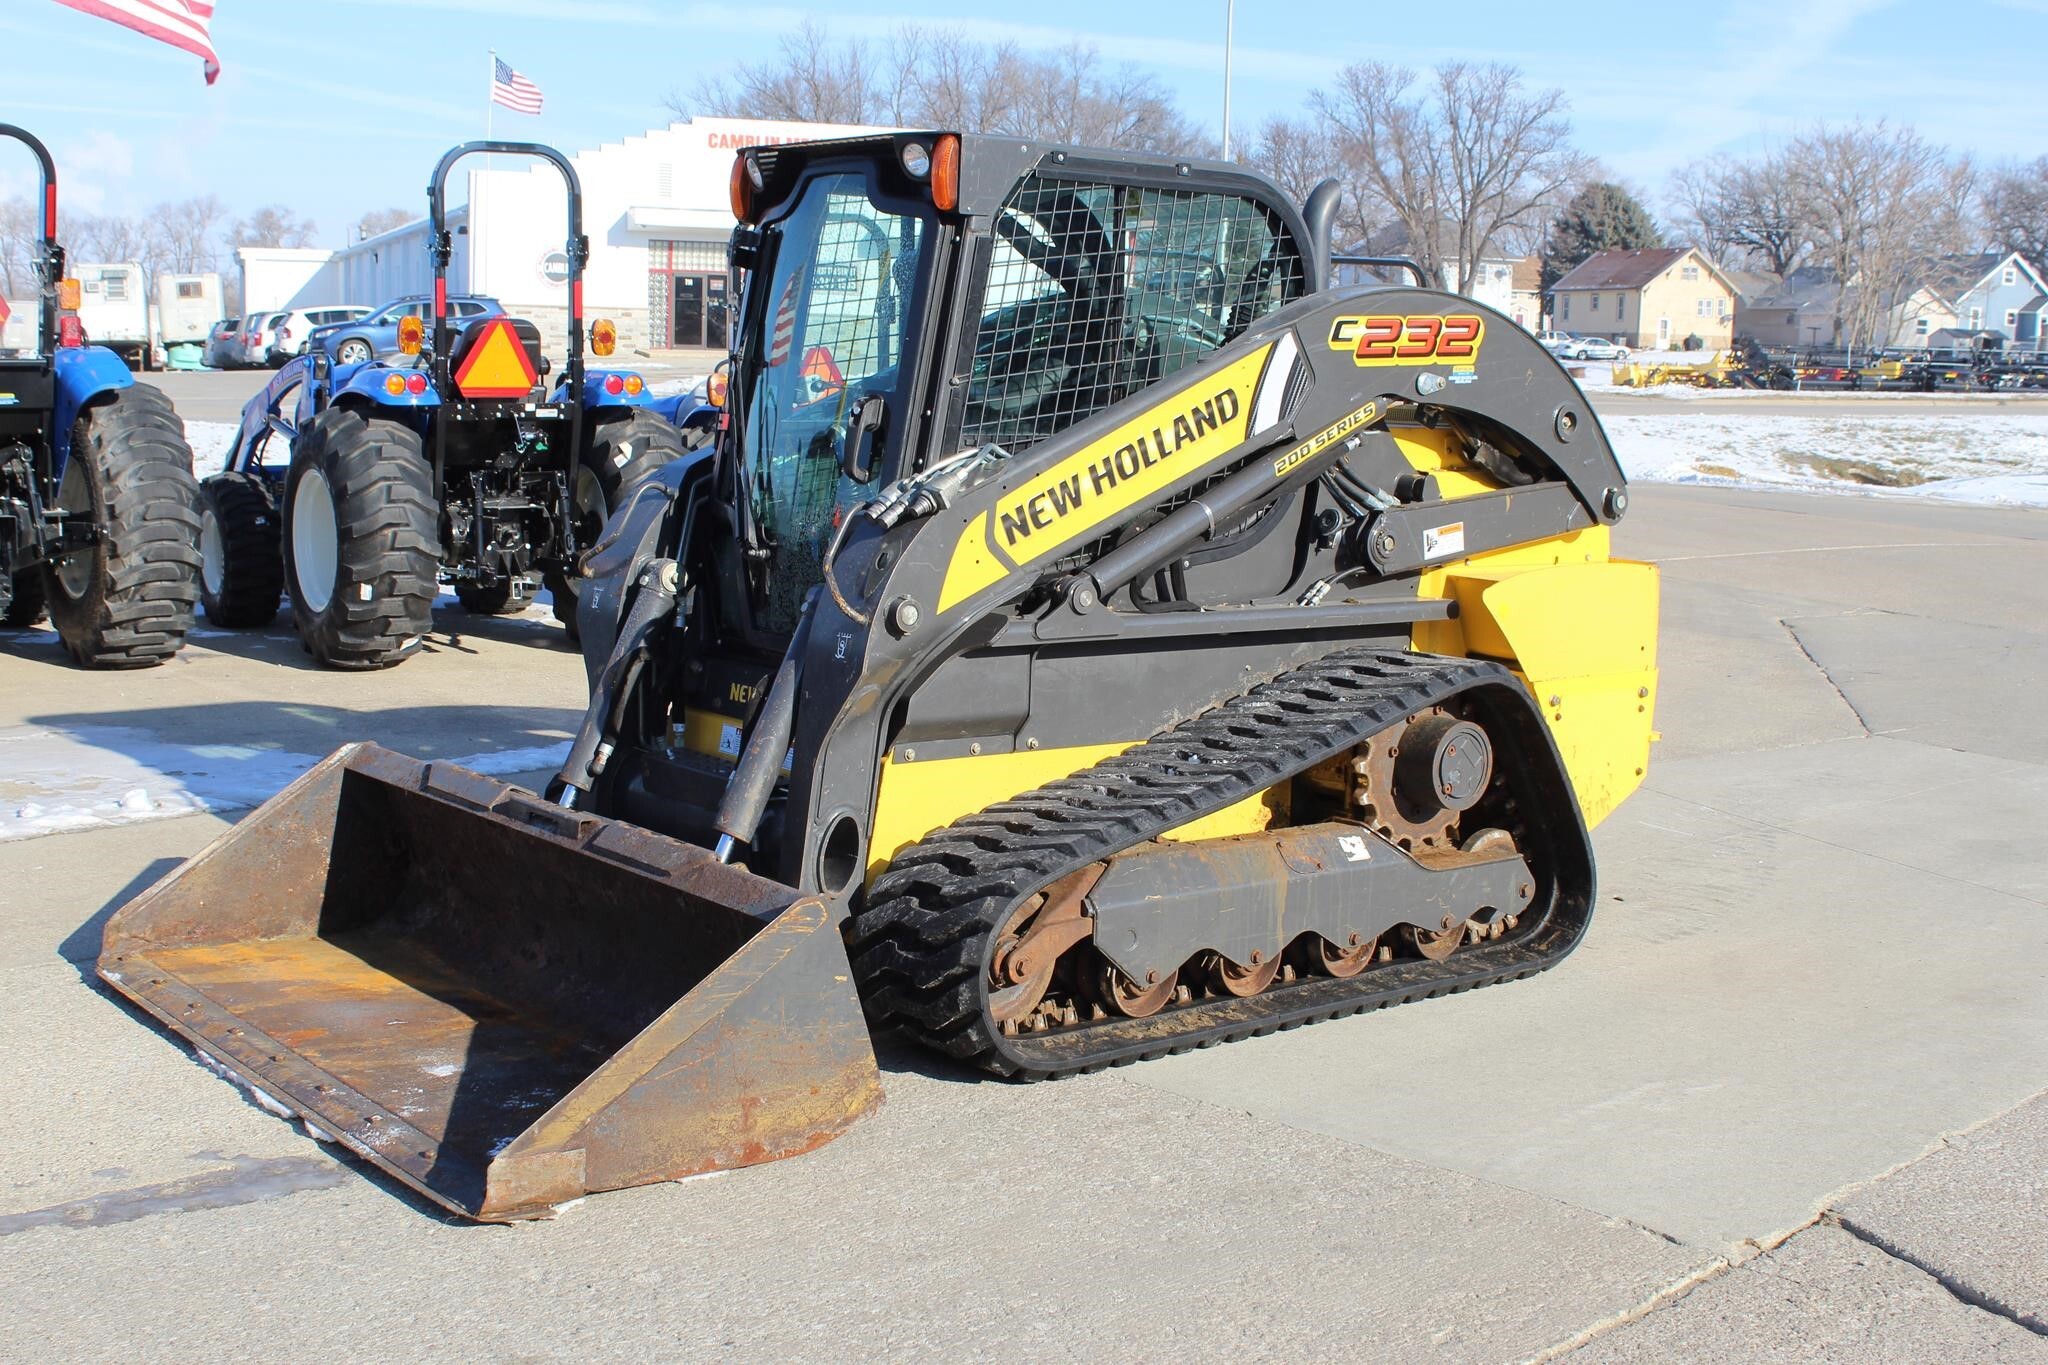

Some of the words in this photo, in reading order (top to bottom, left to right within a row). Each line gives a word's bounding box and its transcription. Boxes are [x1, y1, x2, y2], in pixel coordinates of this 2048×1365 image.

[1000, 473, 1083, 547] NEW
[1088, 387, 1240, 497] HOLLAND
[1274, 445, 1311, 474] 200
[1314, 403, 1374, 450] SERIES
